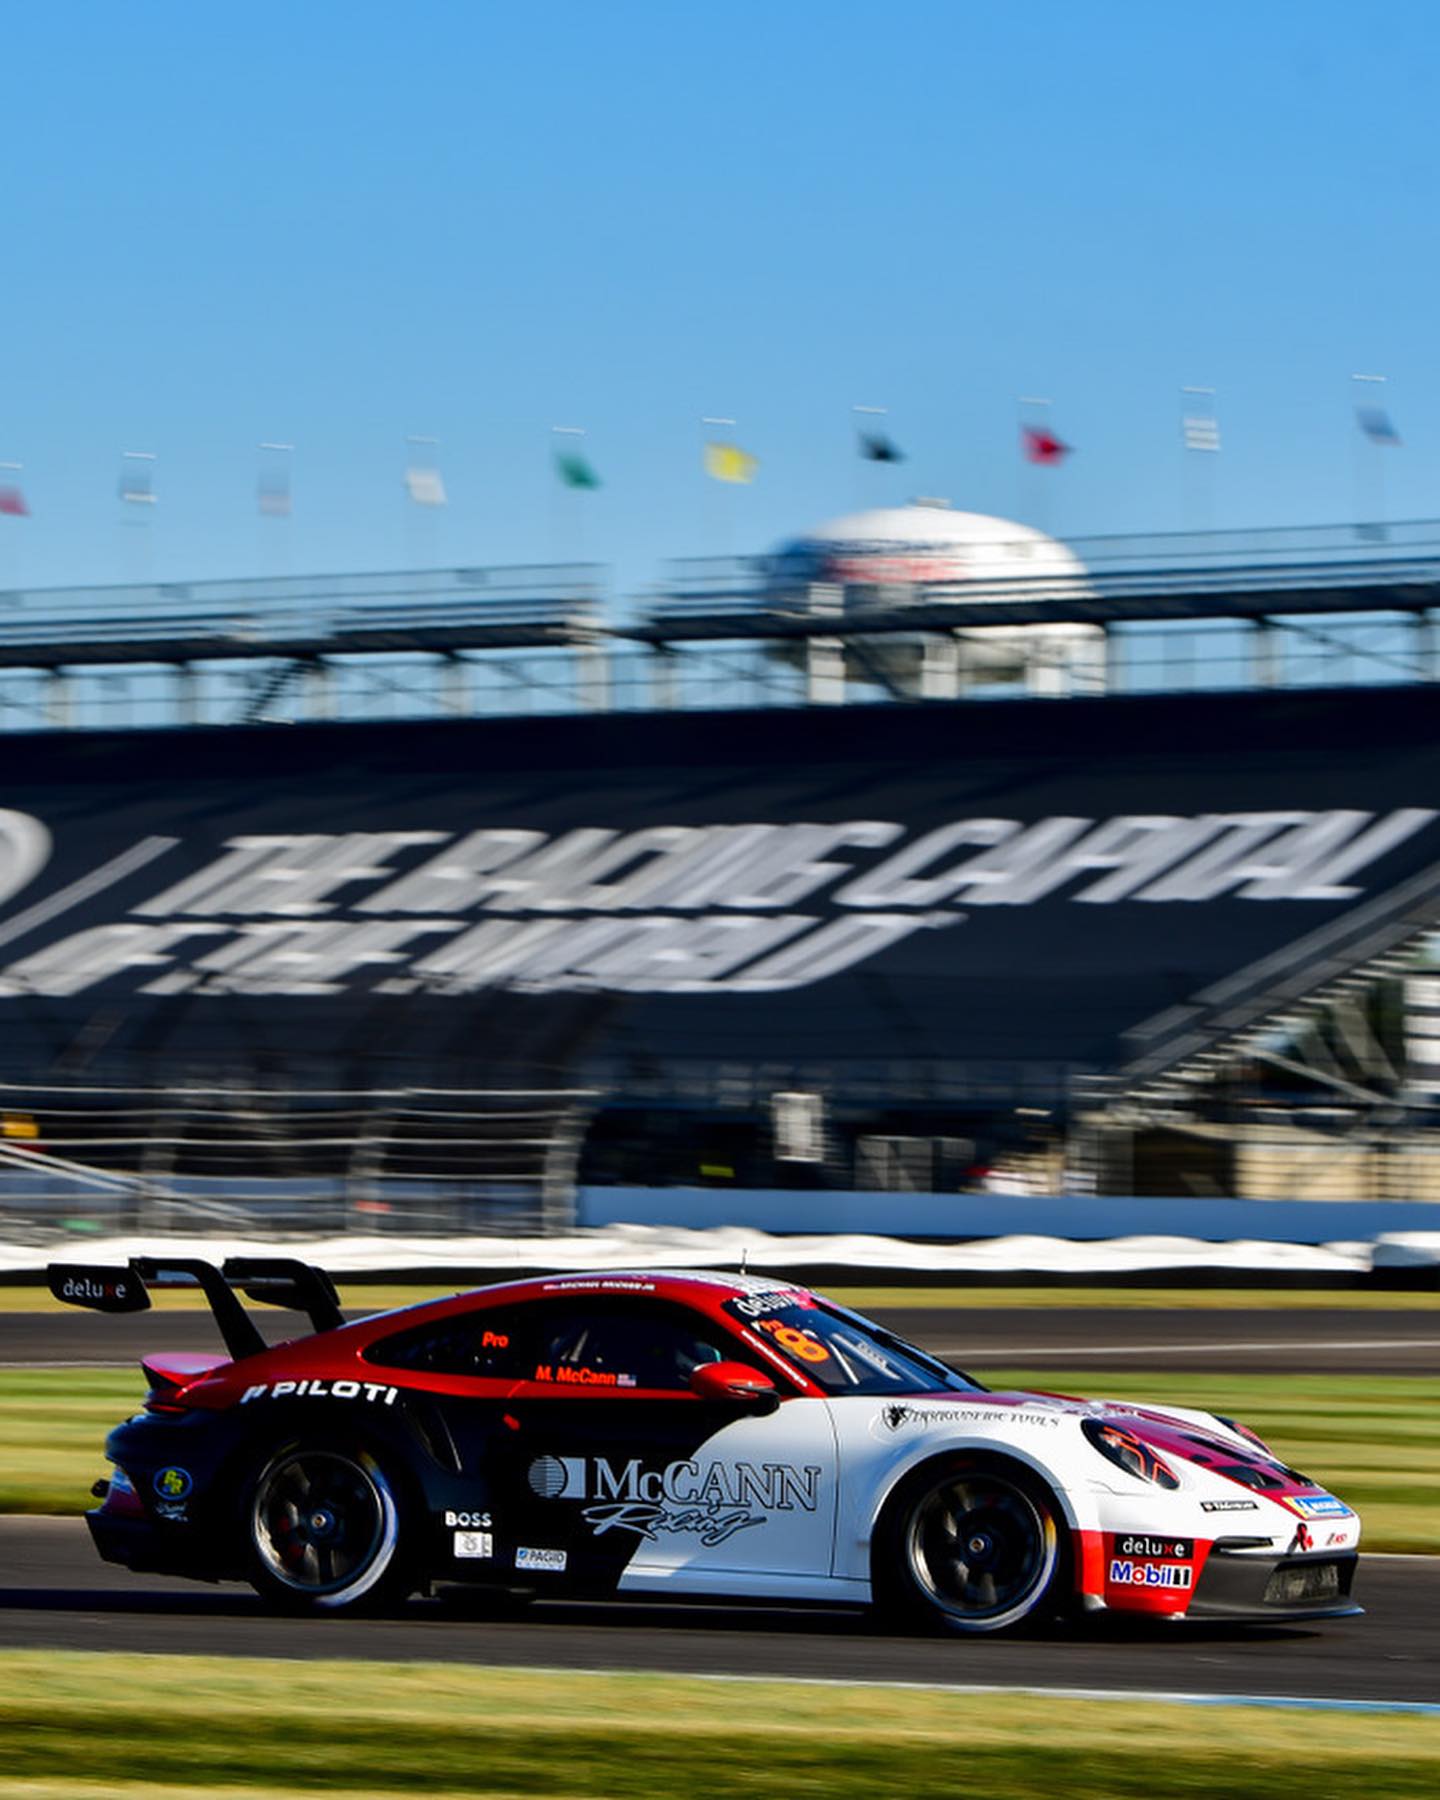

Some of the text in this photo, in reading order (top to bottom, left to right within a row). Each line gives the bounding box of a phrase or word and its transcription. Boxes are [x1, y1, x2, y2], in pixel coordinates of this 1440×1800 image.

[129, 808, 1438, 916] THE RACING CAPITAL
[0, 912, 969, 997] OF THE WORLD
[63, 1278, 126, 1298] deluxe
[482, 1331, 509, 1348] Pro
[774, 1327, 830, 1363] 8
[535, 1365, 616, 1386] M. McCann
[271, 1379, 398, 1405] PILOTI
[593, 1457, 821, 1511] McCANN
[445, 1510, 492, 1527] BOSS
[581, 1502, 768, 1547] Racing
[530, 1550, 565, 1563] PAGID
[1122, 1537, 1185, 1557] deluxe
[1111, 1561, 1171, 1585] Mobil
